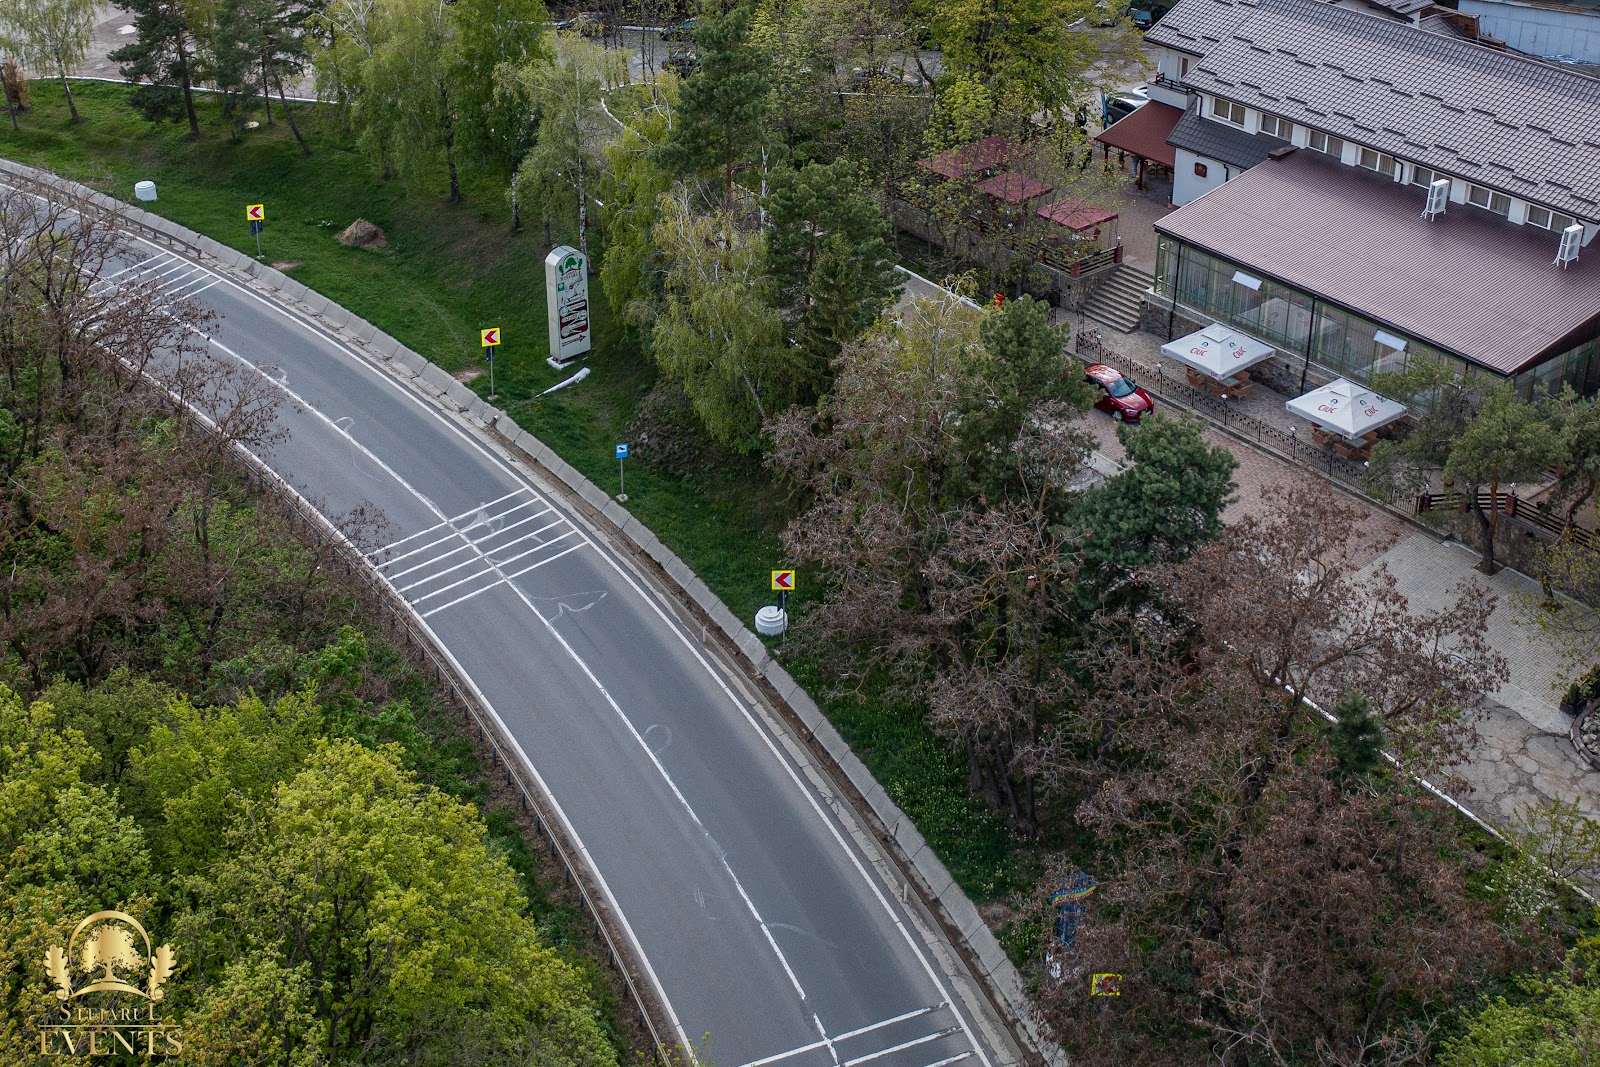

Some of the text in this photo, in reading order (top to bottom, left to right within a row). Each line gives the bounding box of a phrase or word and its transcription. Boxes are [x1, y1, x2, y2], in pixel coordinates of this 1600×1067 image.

[1189, 347, 1208, 357] CIUC
[1232, 346, 1247, 359] CIUC
[1317, 404, 1338, 414] CIUC
[1364, 405, 1379, 417] CIUC
